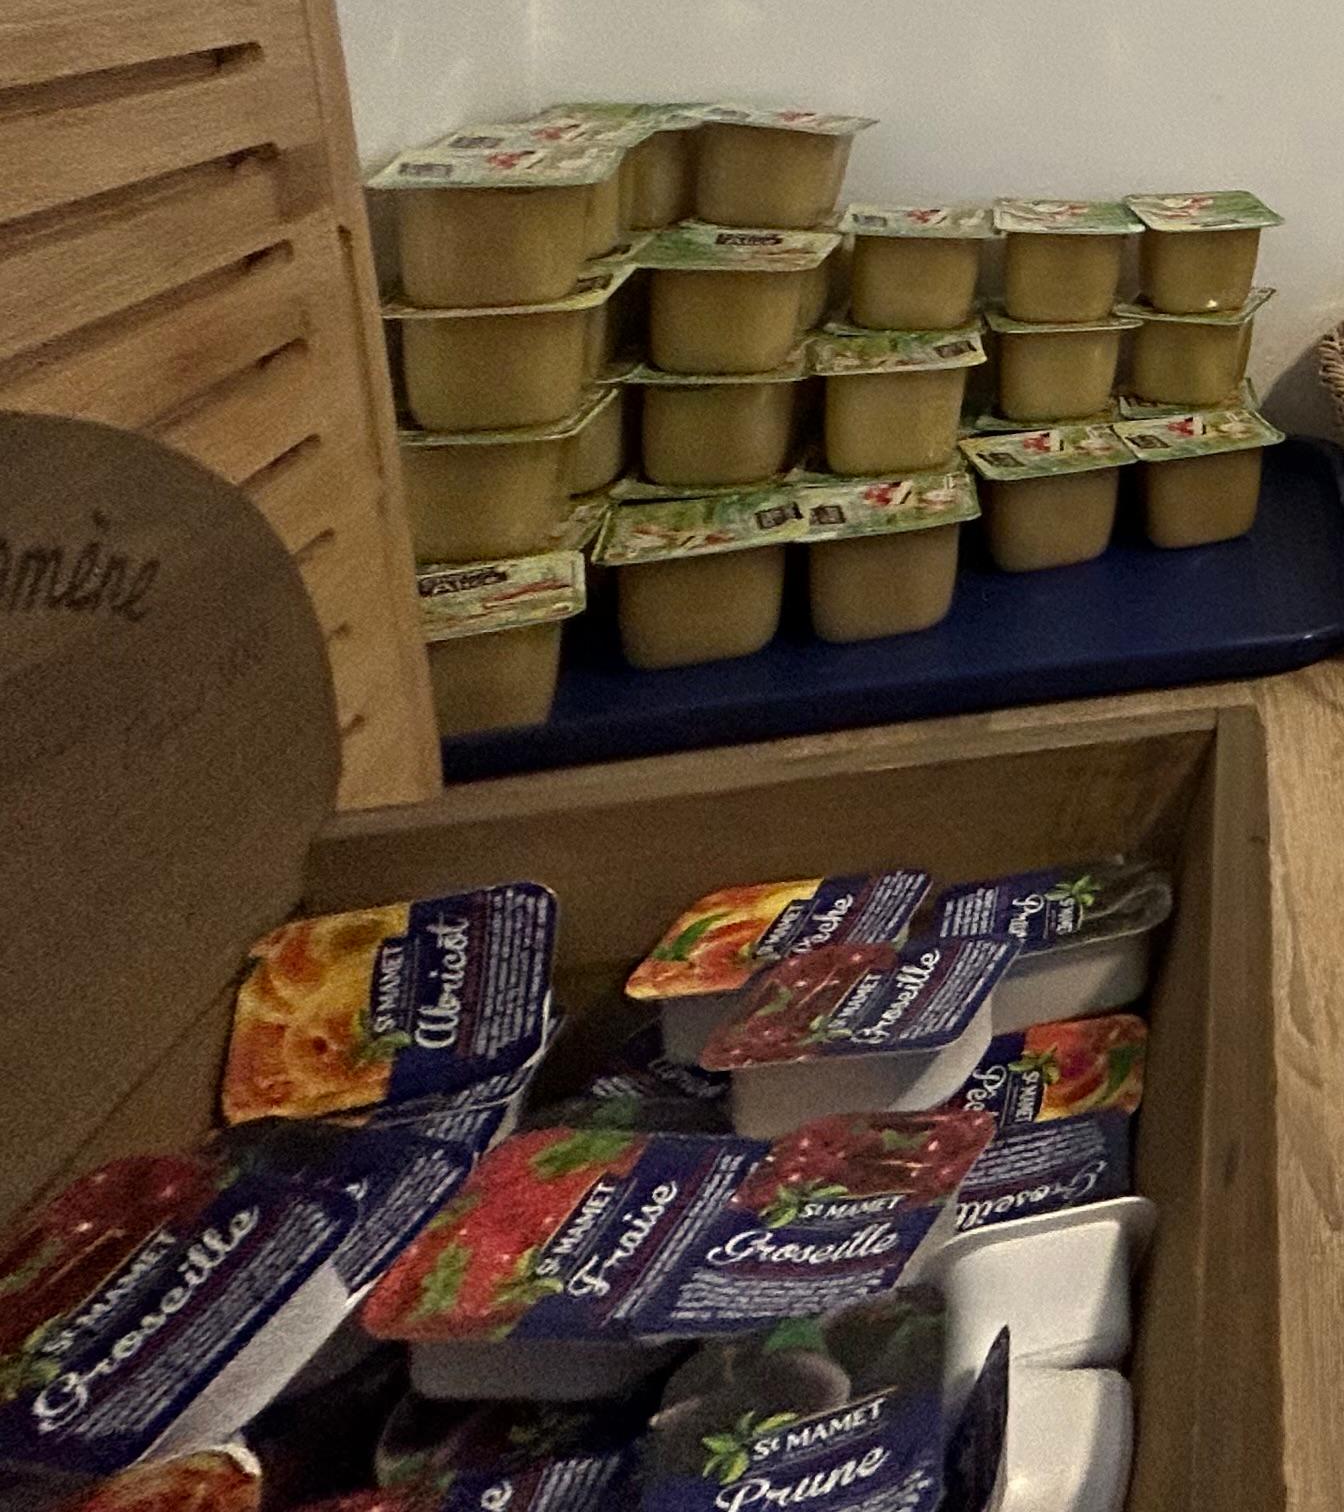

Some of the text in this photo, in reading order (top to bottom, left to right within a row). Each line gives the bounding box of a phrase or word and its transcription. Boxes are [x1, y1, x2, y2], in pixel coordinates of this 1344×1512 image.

[414, 913, 470, 1050] Abricot
[851, 948, 941, 1045] Groseille
[552, 1181, 617, 1256] MAMET
[824, 1194, 906, 1221] MAMET
[955, 1159, 1109, 1231] Groseill
[566, 1180, 679, 1298] Fraise
[706, 1222, 900, 1267] Groseille
[32, 1204, 260, 1435] Groseille
[784, 1395, 887, 1452] MAMET
[715, 1444, 892, 1512] Prune
